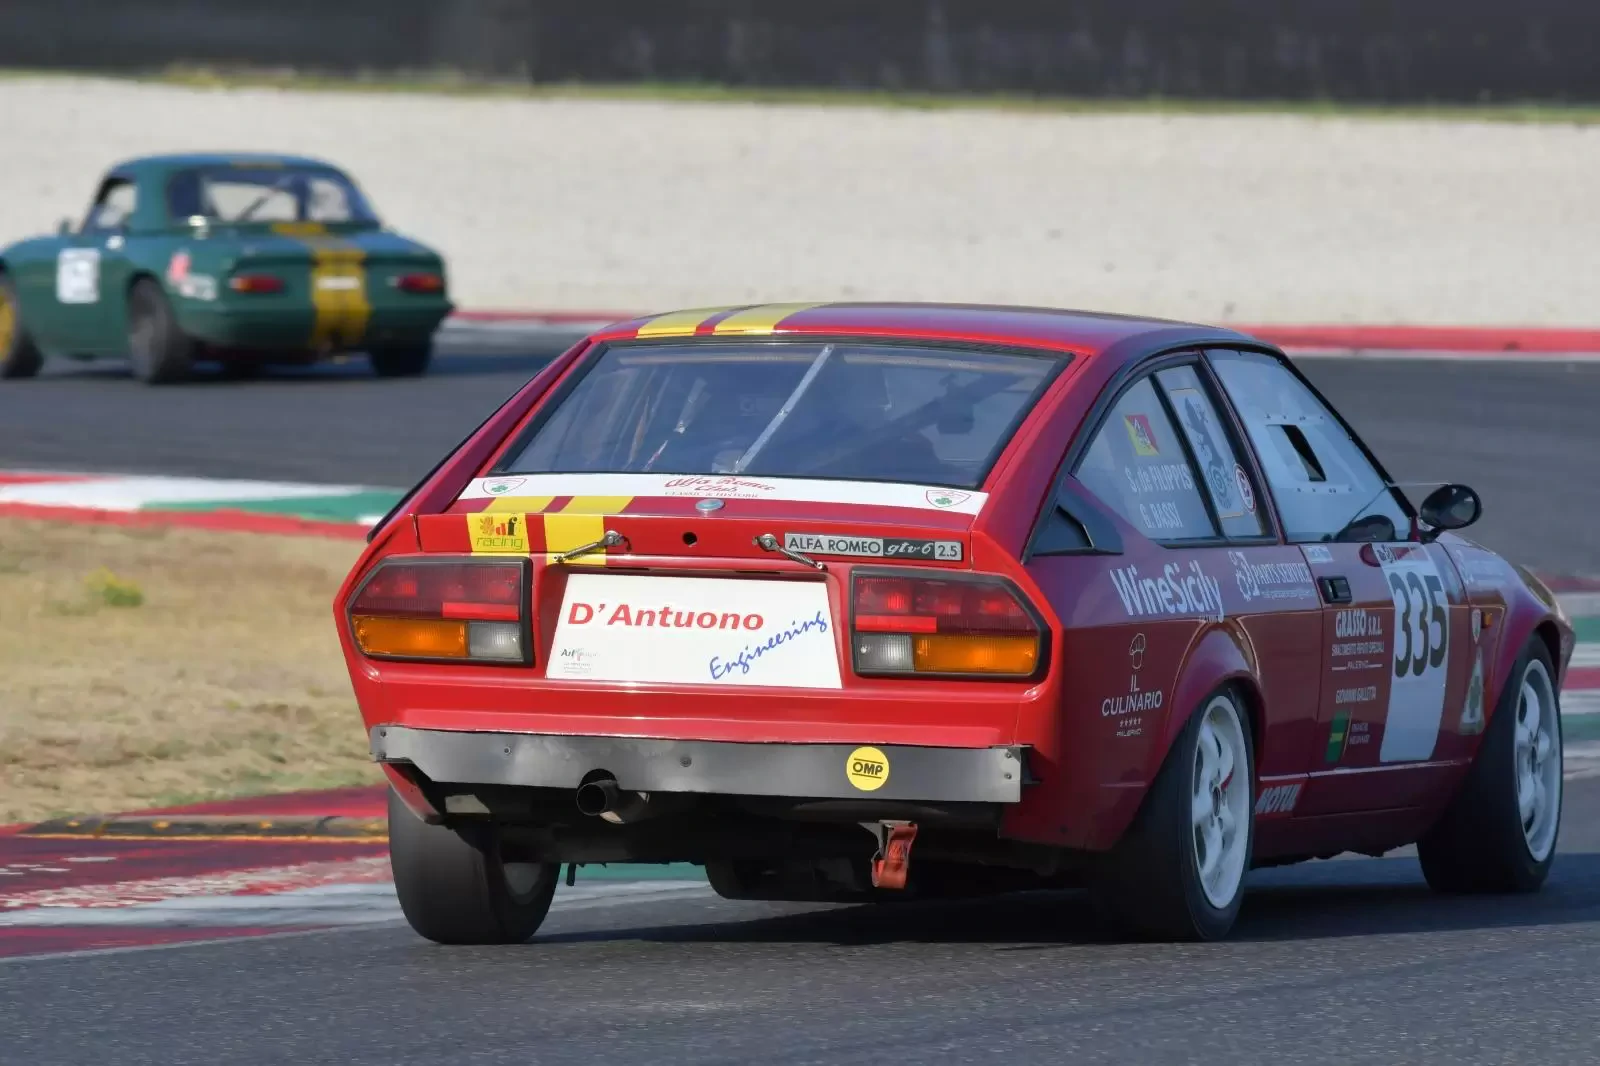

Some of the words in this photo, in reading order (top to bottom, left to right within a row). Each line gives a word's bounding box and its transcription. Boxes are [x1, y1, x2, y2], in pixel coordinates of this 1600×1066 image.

[664, 477, 709, 488] Alfa
[715, 475, 776, 491] Romeo
[476, 537, 523, 550] racing
[788, 536, 825, 551] ALFA
[828, 539, 881, 554] ROMEO
[937, 544, 958, 558] 2.5
[1109, 559, 1224, 623] WineSicily
[567, 602, 764, 631] D'Antuono
[1335, 608, 1367, 638] GRASSO
[1388, 571, 1447, 679] 335
[709, 610, 828, 680] Engineering
[1130, 674, 1140, 692] IL
[1101, 690, 1163, 717] CULINARIO
[852, 761, 884, 776] OMP
